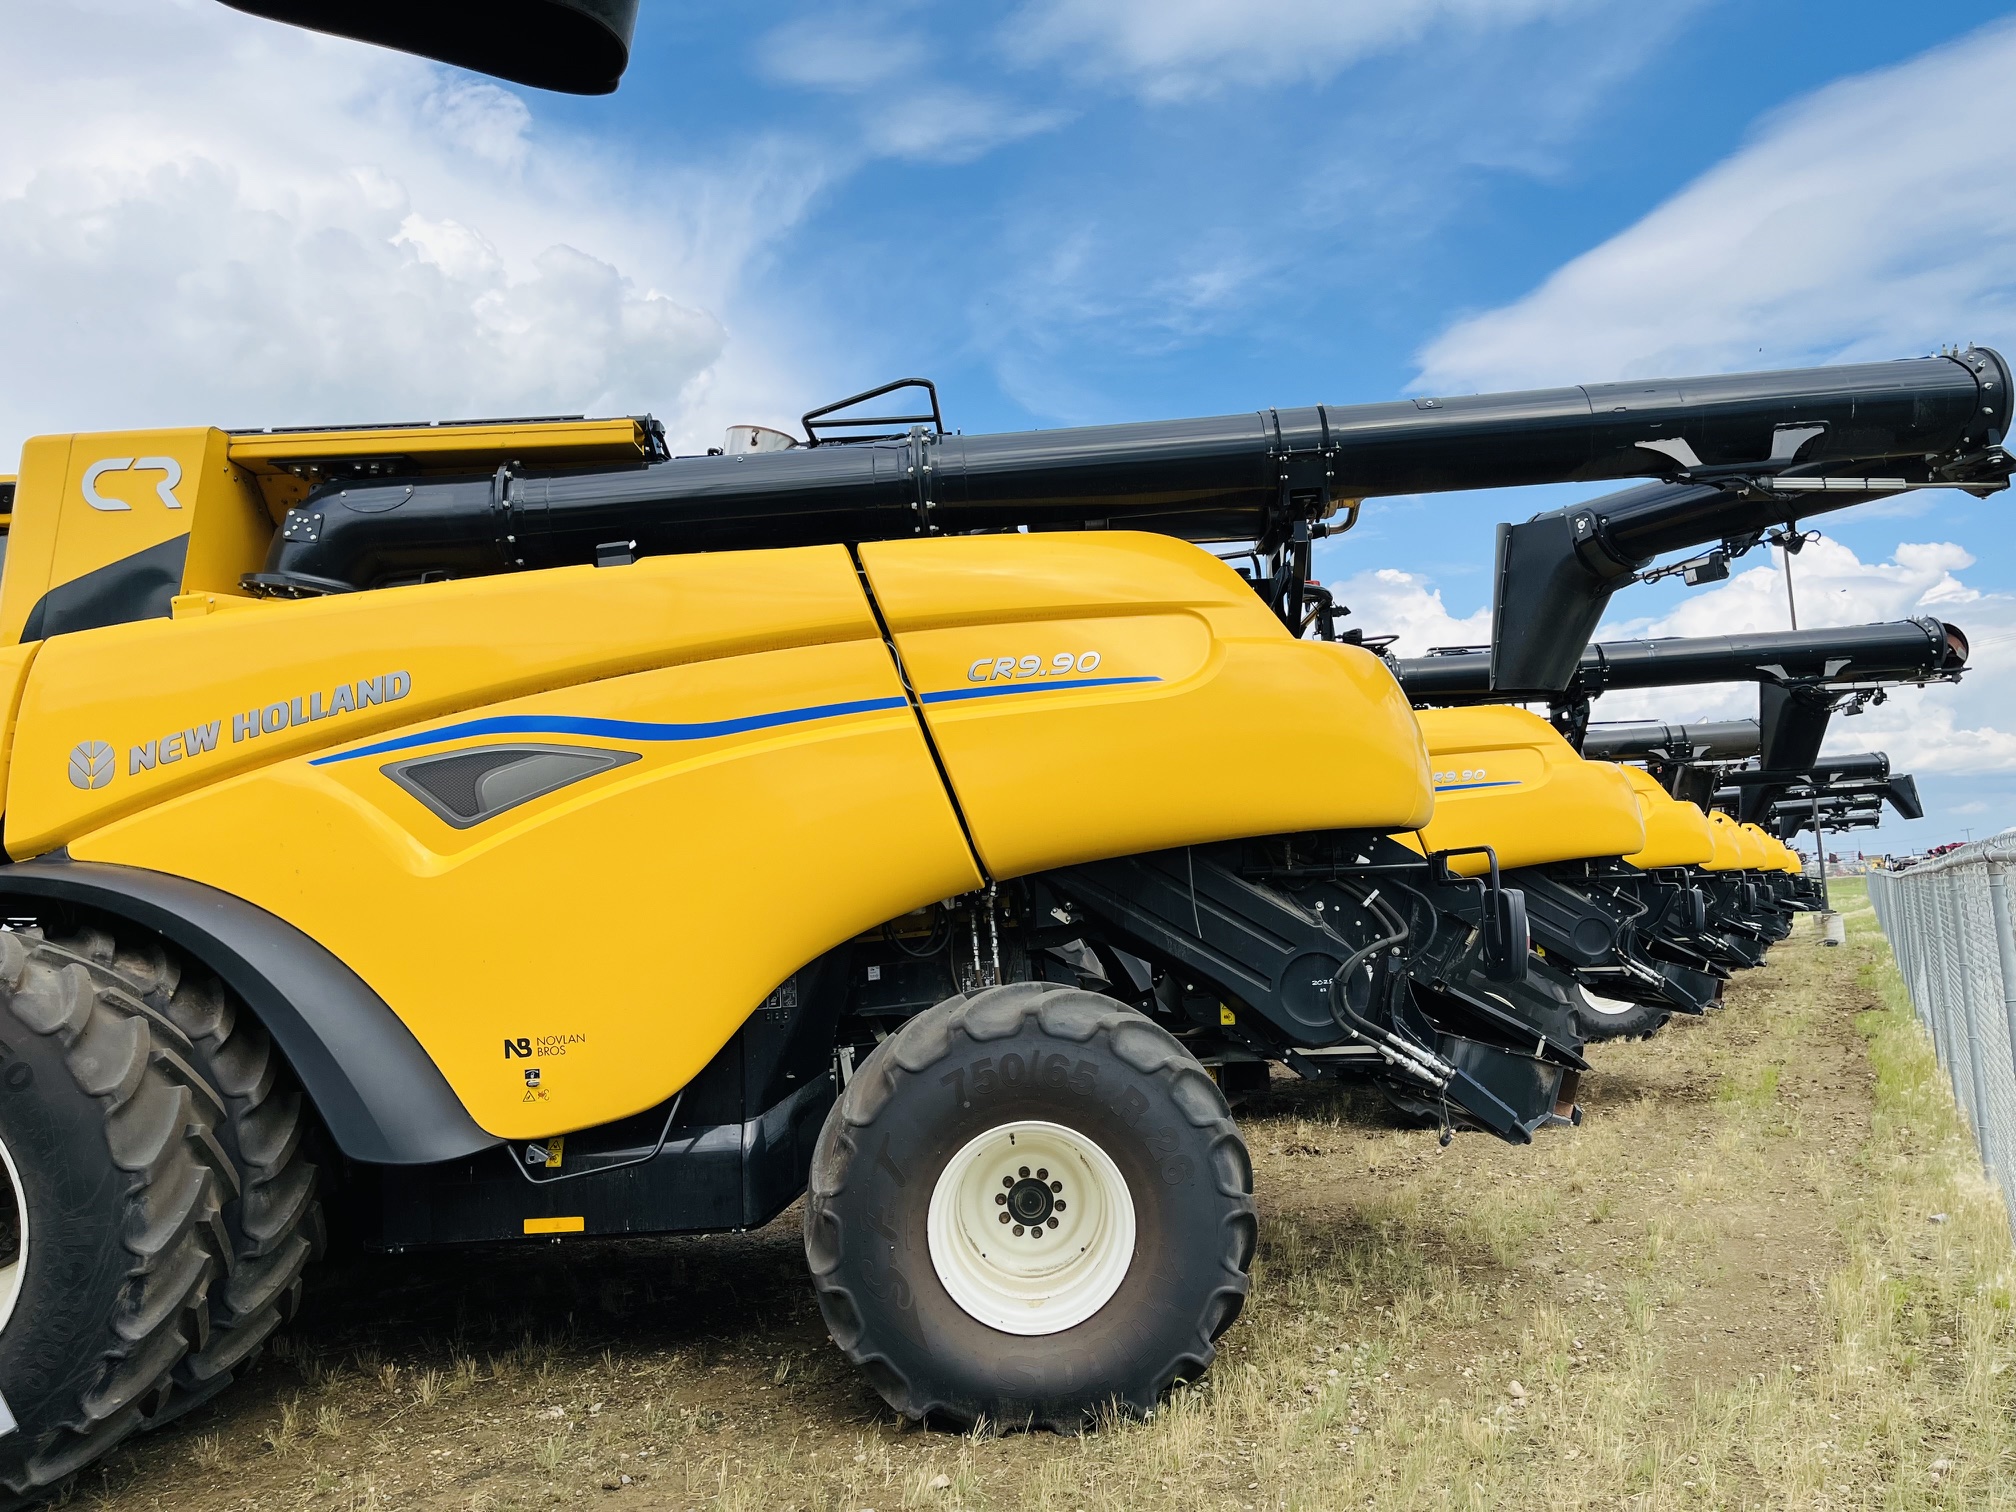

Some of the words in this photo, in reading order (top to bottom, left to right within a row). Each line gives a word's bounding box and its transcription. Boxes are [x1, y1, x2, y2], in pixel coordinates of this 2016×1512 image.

[82, 456, 183, 511] CR
[967, 651, 1102, 682] CR9.90
[129, 720, 221, 776] NEW
[233, 670, 412, 743] HOLLAND
[1433, 769, 1486, 783] R9.90
[504, 1038, 533, 1059] NB
[536, 1033, 586, 1047] NOVLAN
[537, 1045, 566, 1057] BROS
[940, 1050, 1100, 1108] 750/65
[1111, 1084, 1150, 1130] R
[1146, 1127, 1196, 1187] 26
